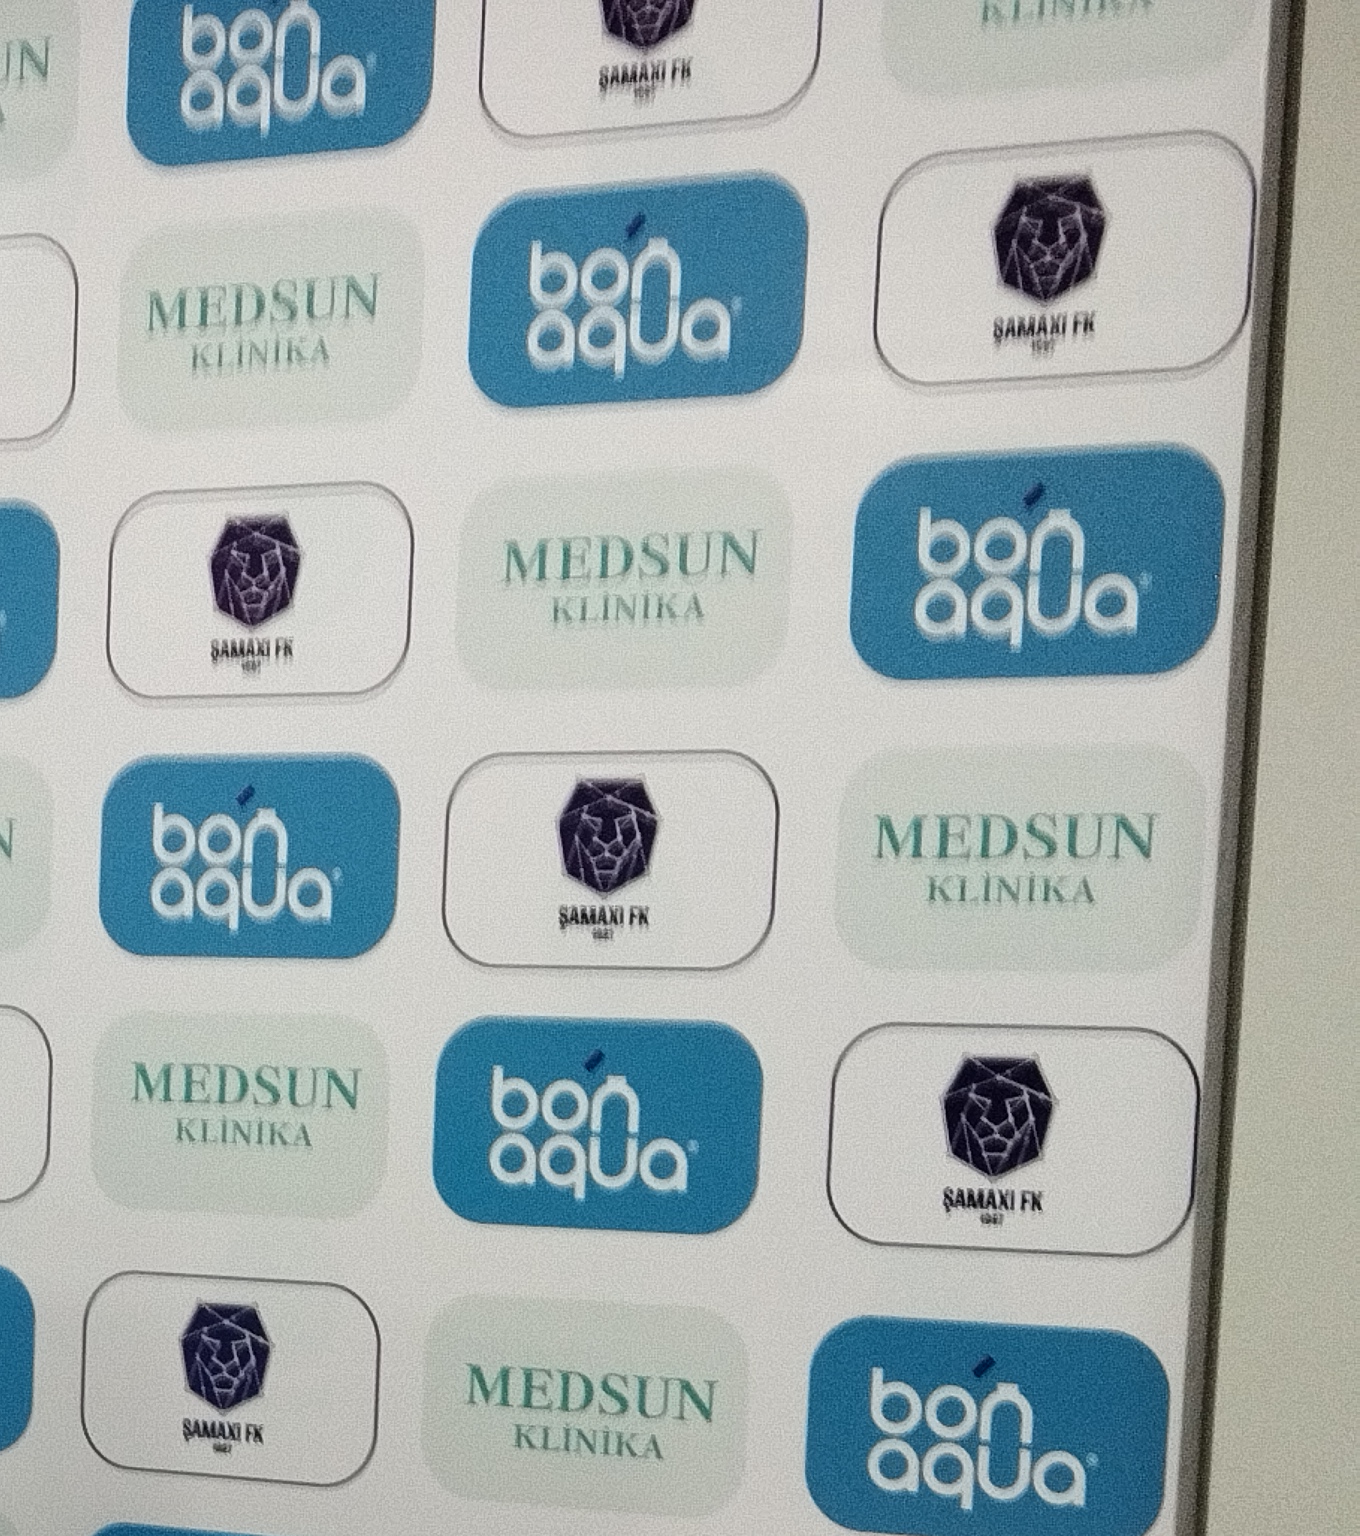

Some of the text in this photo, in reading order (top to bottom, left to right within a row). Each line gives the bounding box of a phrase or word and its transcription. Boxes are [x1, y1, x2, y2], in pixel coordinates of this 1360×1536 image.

[180, 0, 321, 69] bon
[178, 56, 368, 131] aqua
[669, 57, 694, 82] FK
[143, 272, 384, 333] MEDSUN
[528, 238, 682, 307] bon
[525, 299, 733, 374] aqua
[994, 310, 1098, 344] ŞAMAXI FK
[500, 529, 764, 583] MEDSUN
[916, 506, 1086, 576] bon
[913, 573, 1141, 647] aqua
[150, 802, 288, 865] bon
[871, 812, 1160, 861] MEDSUN
[148, 867, 334, 930] aqua
[627, 905, 651, 928] FK
[129, 1060, 365, 1111] MEDSUN
[489, 1063, 640, 1133] bon
[487, 1132, 689, 1200] aqua
[943, 1186, 1045, 1214] ŞAMAXI FK
[463, 1361, 720, 1424] MEDSUN
[869, 1365, 1034, 1444] bon
[866, 1437, 1088, 1511] aqua
